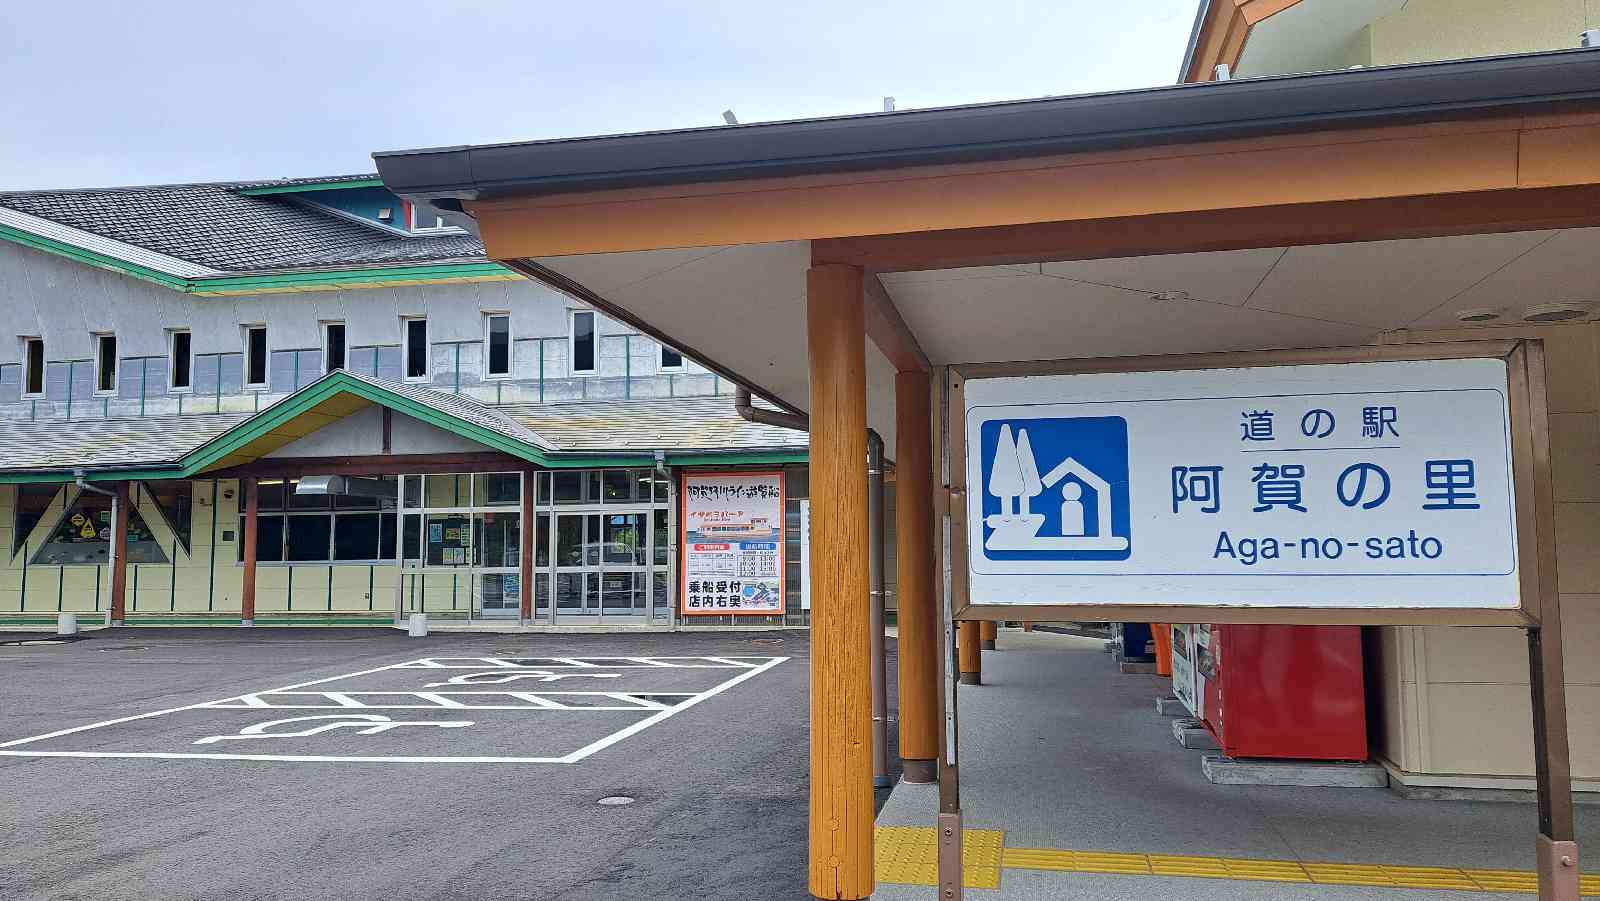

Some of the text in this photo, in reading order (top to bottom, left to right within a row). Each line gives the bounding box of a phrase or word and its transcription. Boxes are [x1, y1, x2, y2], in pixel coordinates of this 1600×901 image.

[1240, 406, 1399, 441] 道の駅
[1171, 458, 1481, 514] 阿賀の里
[1213, 528, 1443, 566] Aga-no-sato
[688, 581, 742, 593] 乗船受付
[688, 595, 742, 608] 店内右奥
